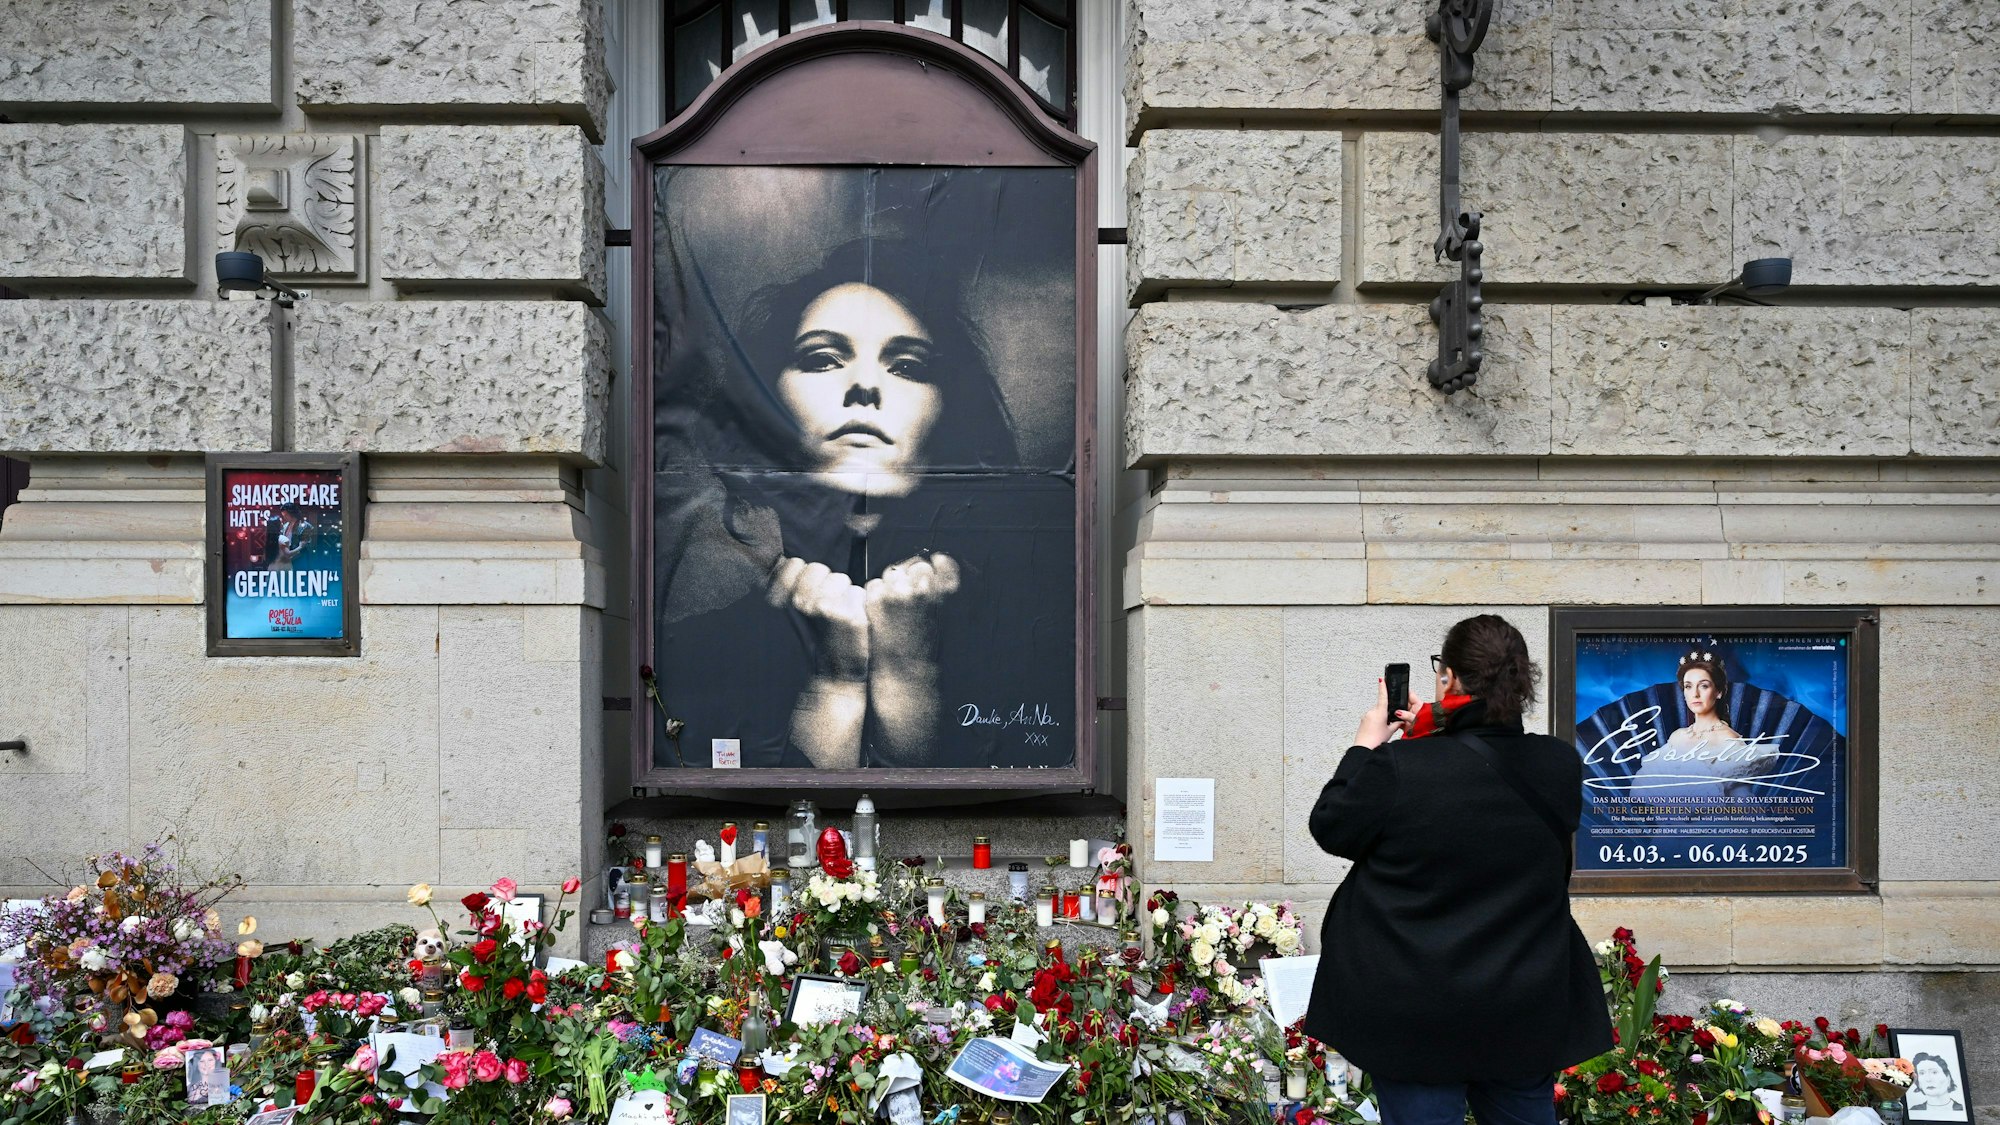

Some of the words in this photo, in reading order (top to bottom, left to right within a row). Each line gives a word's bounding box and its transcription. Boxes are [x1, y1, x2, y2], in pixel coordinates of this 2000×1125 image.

[269, 608, 294, 623] ROMEO
[275, 617, 281, 625] &
[282, 616, 302, 625] JULIA
[1583, 705, 1825, 795] Elisabeth
[1593, 796, 1609, 804] DAS
[1610, 796, 1646, 804] MUSICAL
[1648, 796, 1666, 804] VON
[1668, 796, 1705, 804] MICHAEL
[1707, 796, 1735, 804] KUNZE
[1737, 796, 1744, 804] &
[1746, 796, 1789, 804] SYLVESTER
[1790, 796, 1815, 804] LEVAY
[1593, 806, 1604, 814] IN
[1608, 806, 1628, 814] DER
[1630, 806, 1691, 814] GEFEIERTEN
[1694, 804, 1814, 814] SCHÖNBRUNN-VERSION
[1599, 844, 1666, 863] 04.03.
[1688, 844, 1808, 863] 06.04.2025
